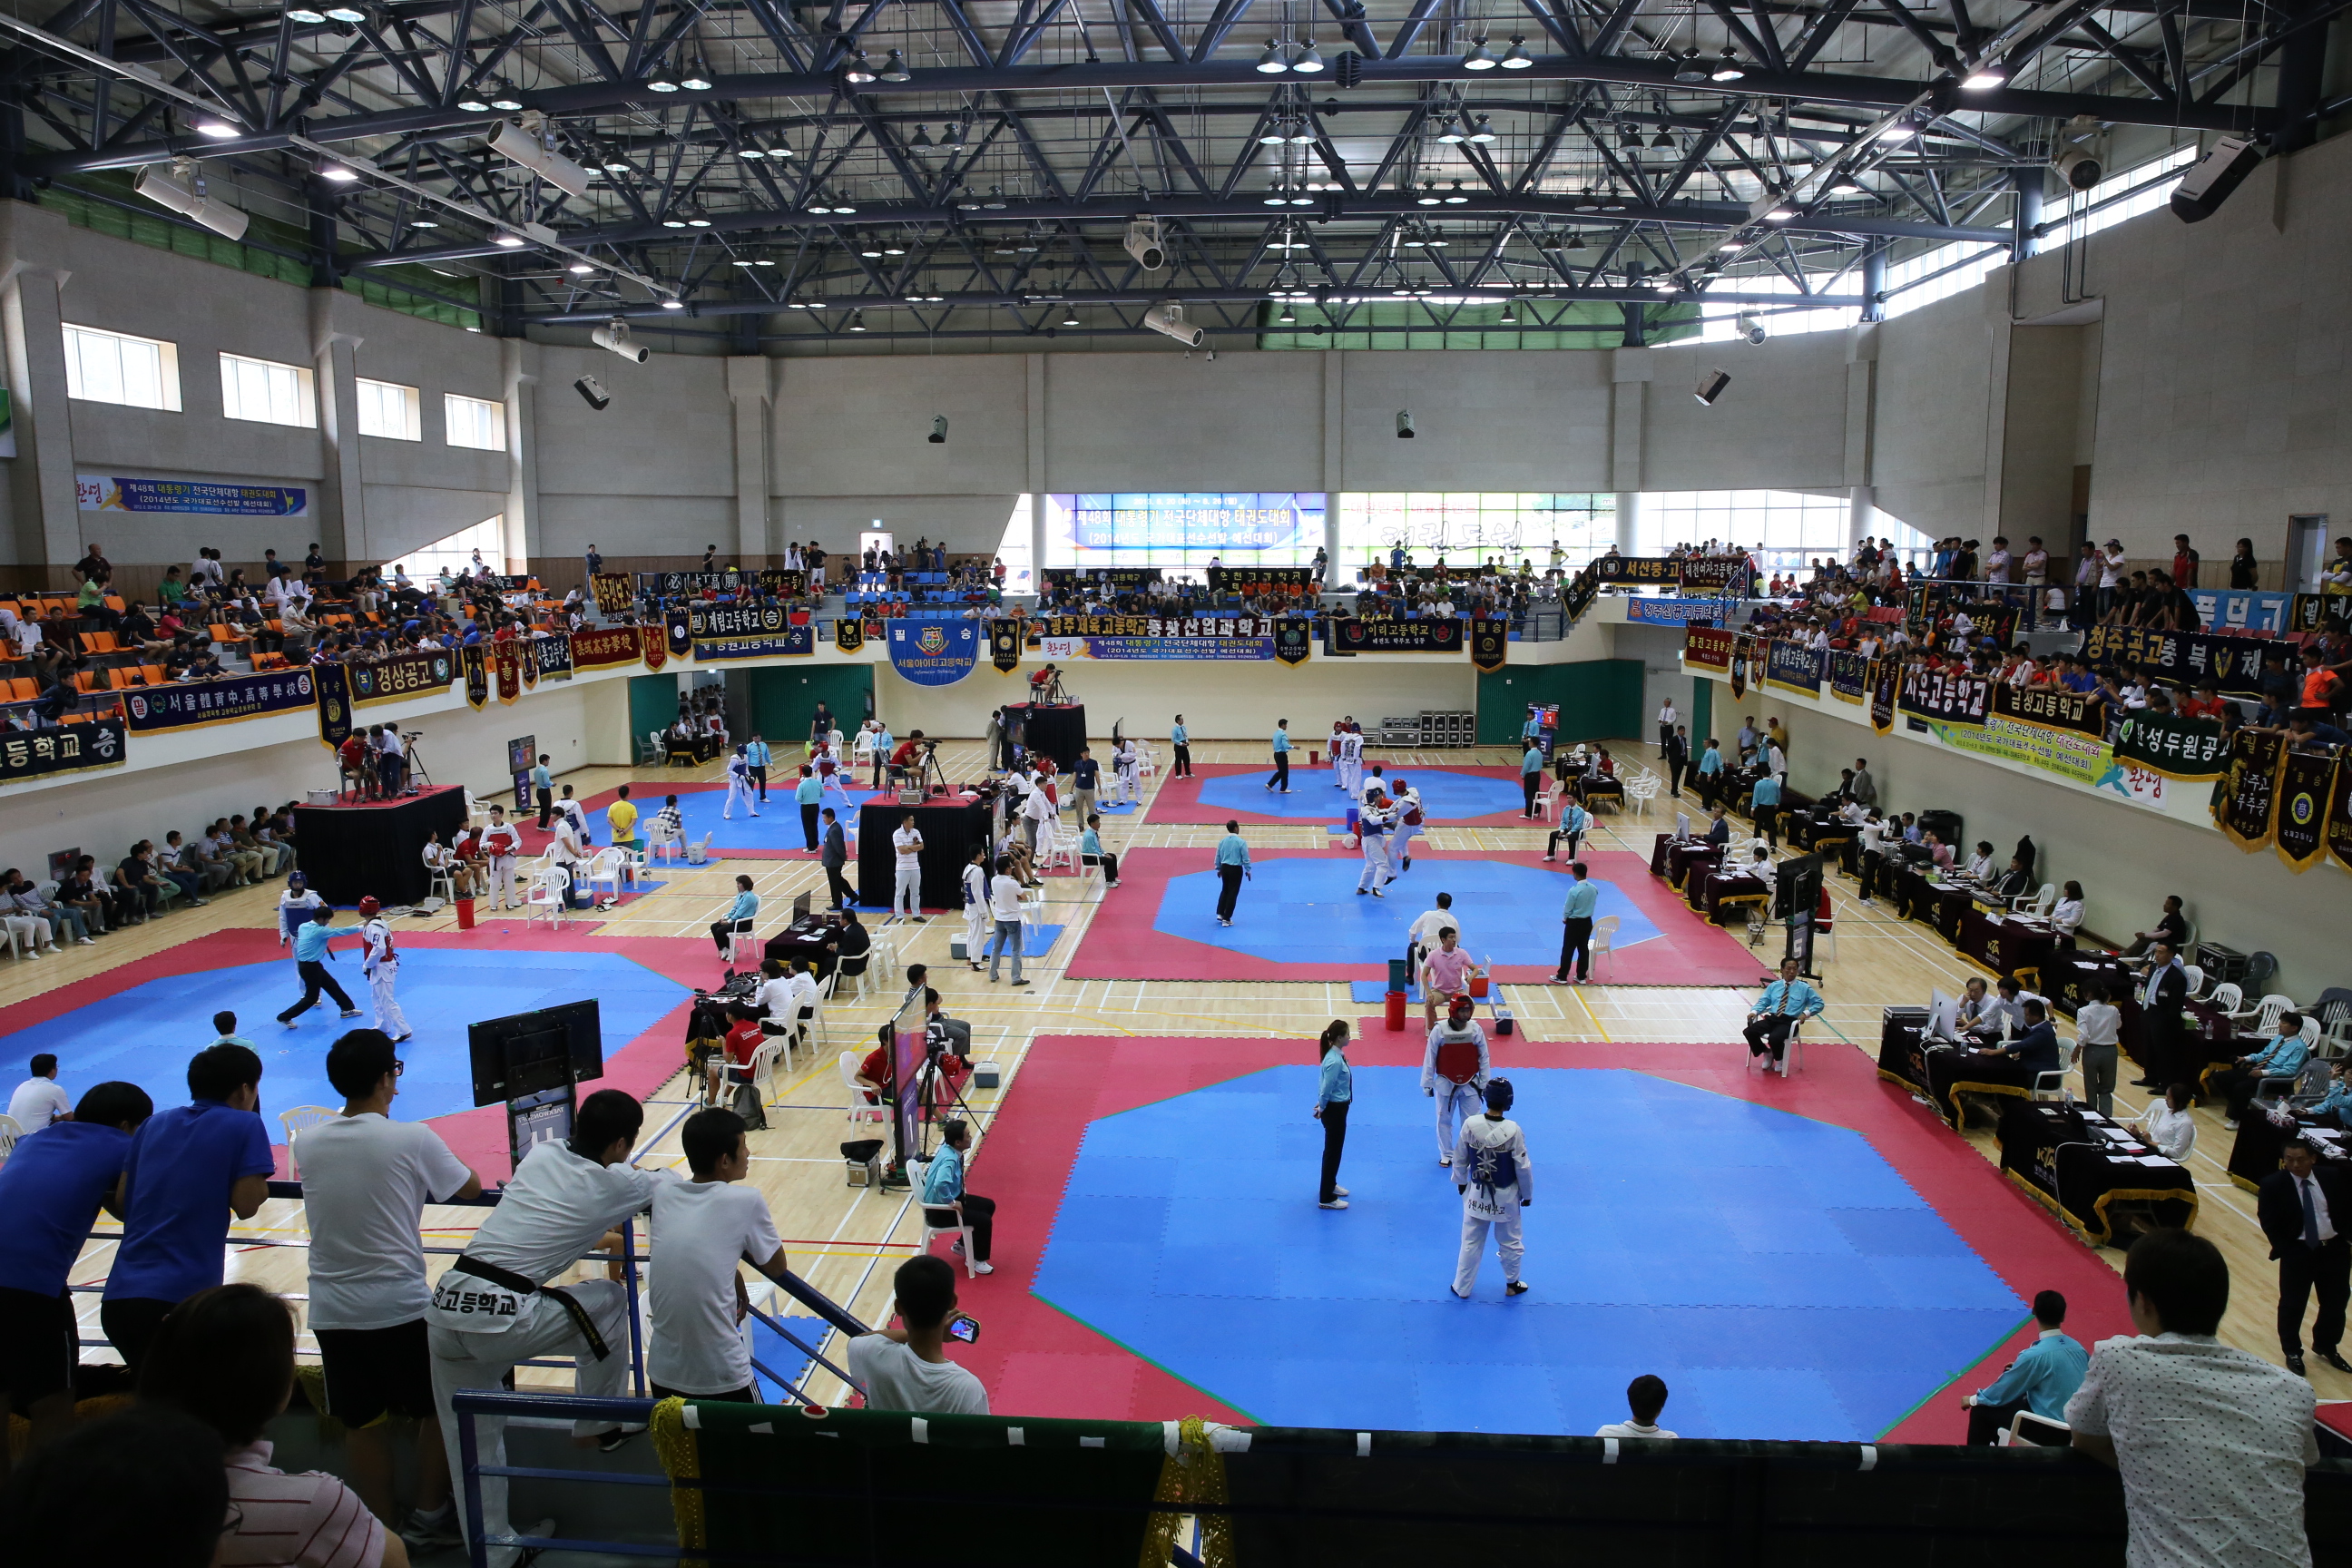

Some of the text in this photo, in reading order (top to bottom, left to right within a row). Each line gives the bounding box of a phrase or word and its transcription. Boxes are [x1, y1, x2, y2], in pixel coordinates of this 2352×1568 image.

[129, 484, 277, 499] 제48회 대통령기 전국단체대항 태권도대회
[139, 495, 272, 508] (2014년도 국가대표선수선발 예선대회)
[1351, 501, 1478, 514] 대한민국 대표브랜드
[1076, 509, 1291, 528] 제48회 대통령기 전국단체대항 태권도대회
[1089, 532, 1279, 545] (2014년도 국가대표선수선발 예선대회)
[1380, 520, 1524, 556] 태권도원
[1625, 562, 1680, 577] 서산중·고
[667, 573, 681, 591] 必
[724, 573, 740, 590] 勝
[765, 611, 779, 624] 승
[895, 627, 972, 642] 필 승
[1050, 617, 1146, 636] 광주체육고등학교
[1146, 617, 1272, 638] 동광산업과학고
[1279, 622, 1307, 632] 필 승
[1367, 623, 1429, 637] 이리고등학교
[1436, 625, 1449, 639] 승
[1477, 622, 1502, 633] 필 승
[790, 632, 803, 646] 승
[1097, 639, 1263, 648] 제48회 대통령기 전국단체대항 태권도대회
[1688, 634, 1730, 653] 통진고등학교
[2088, 625, 2165, 665] 청주공고
[1046, 642, 1072, 656] 환영
[897, 657, 973, 669] 서울아이티고등학교
[299, 676, 309, 692] 승
[377, 661, 433, 693] 경상공고
[1905, 671, 1987, 717] 사우고등학교
[1547, 715, 1553, 723] 1
[0, 728, 117, 769] 등학교 승
[1540, 740, 1547, 752] 3
[1961, 729, 1994, 744] (2014년도
[2055, 752, 2092, 771] 예선대회)
[2056, 734, 2102, 760] 태권도대회
[2243, 735, 2258, 754] 필
[521, 786, 526, 800] 5
[1987, 939, 2000, 956] KTA
[2064, 983, 2078, 1000] KTA
[907, 1113, 914, 1143] 1
